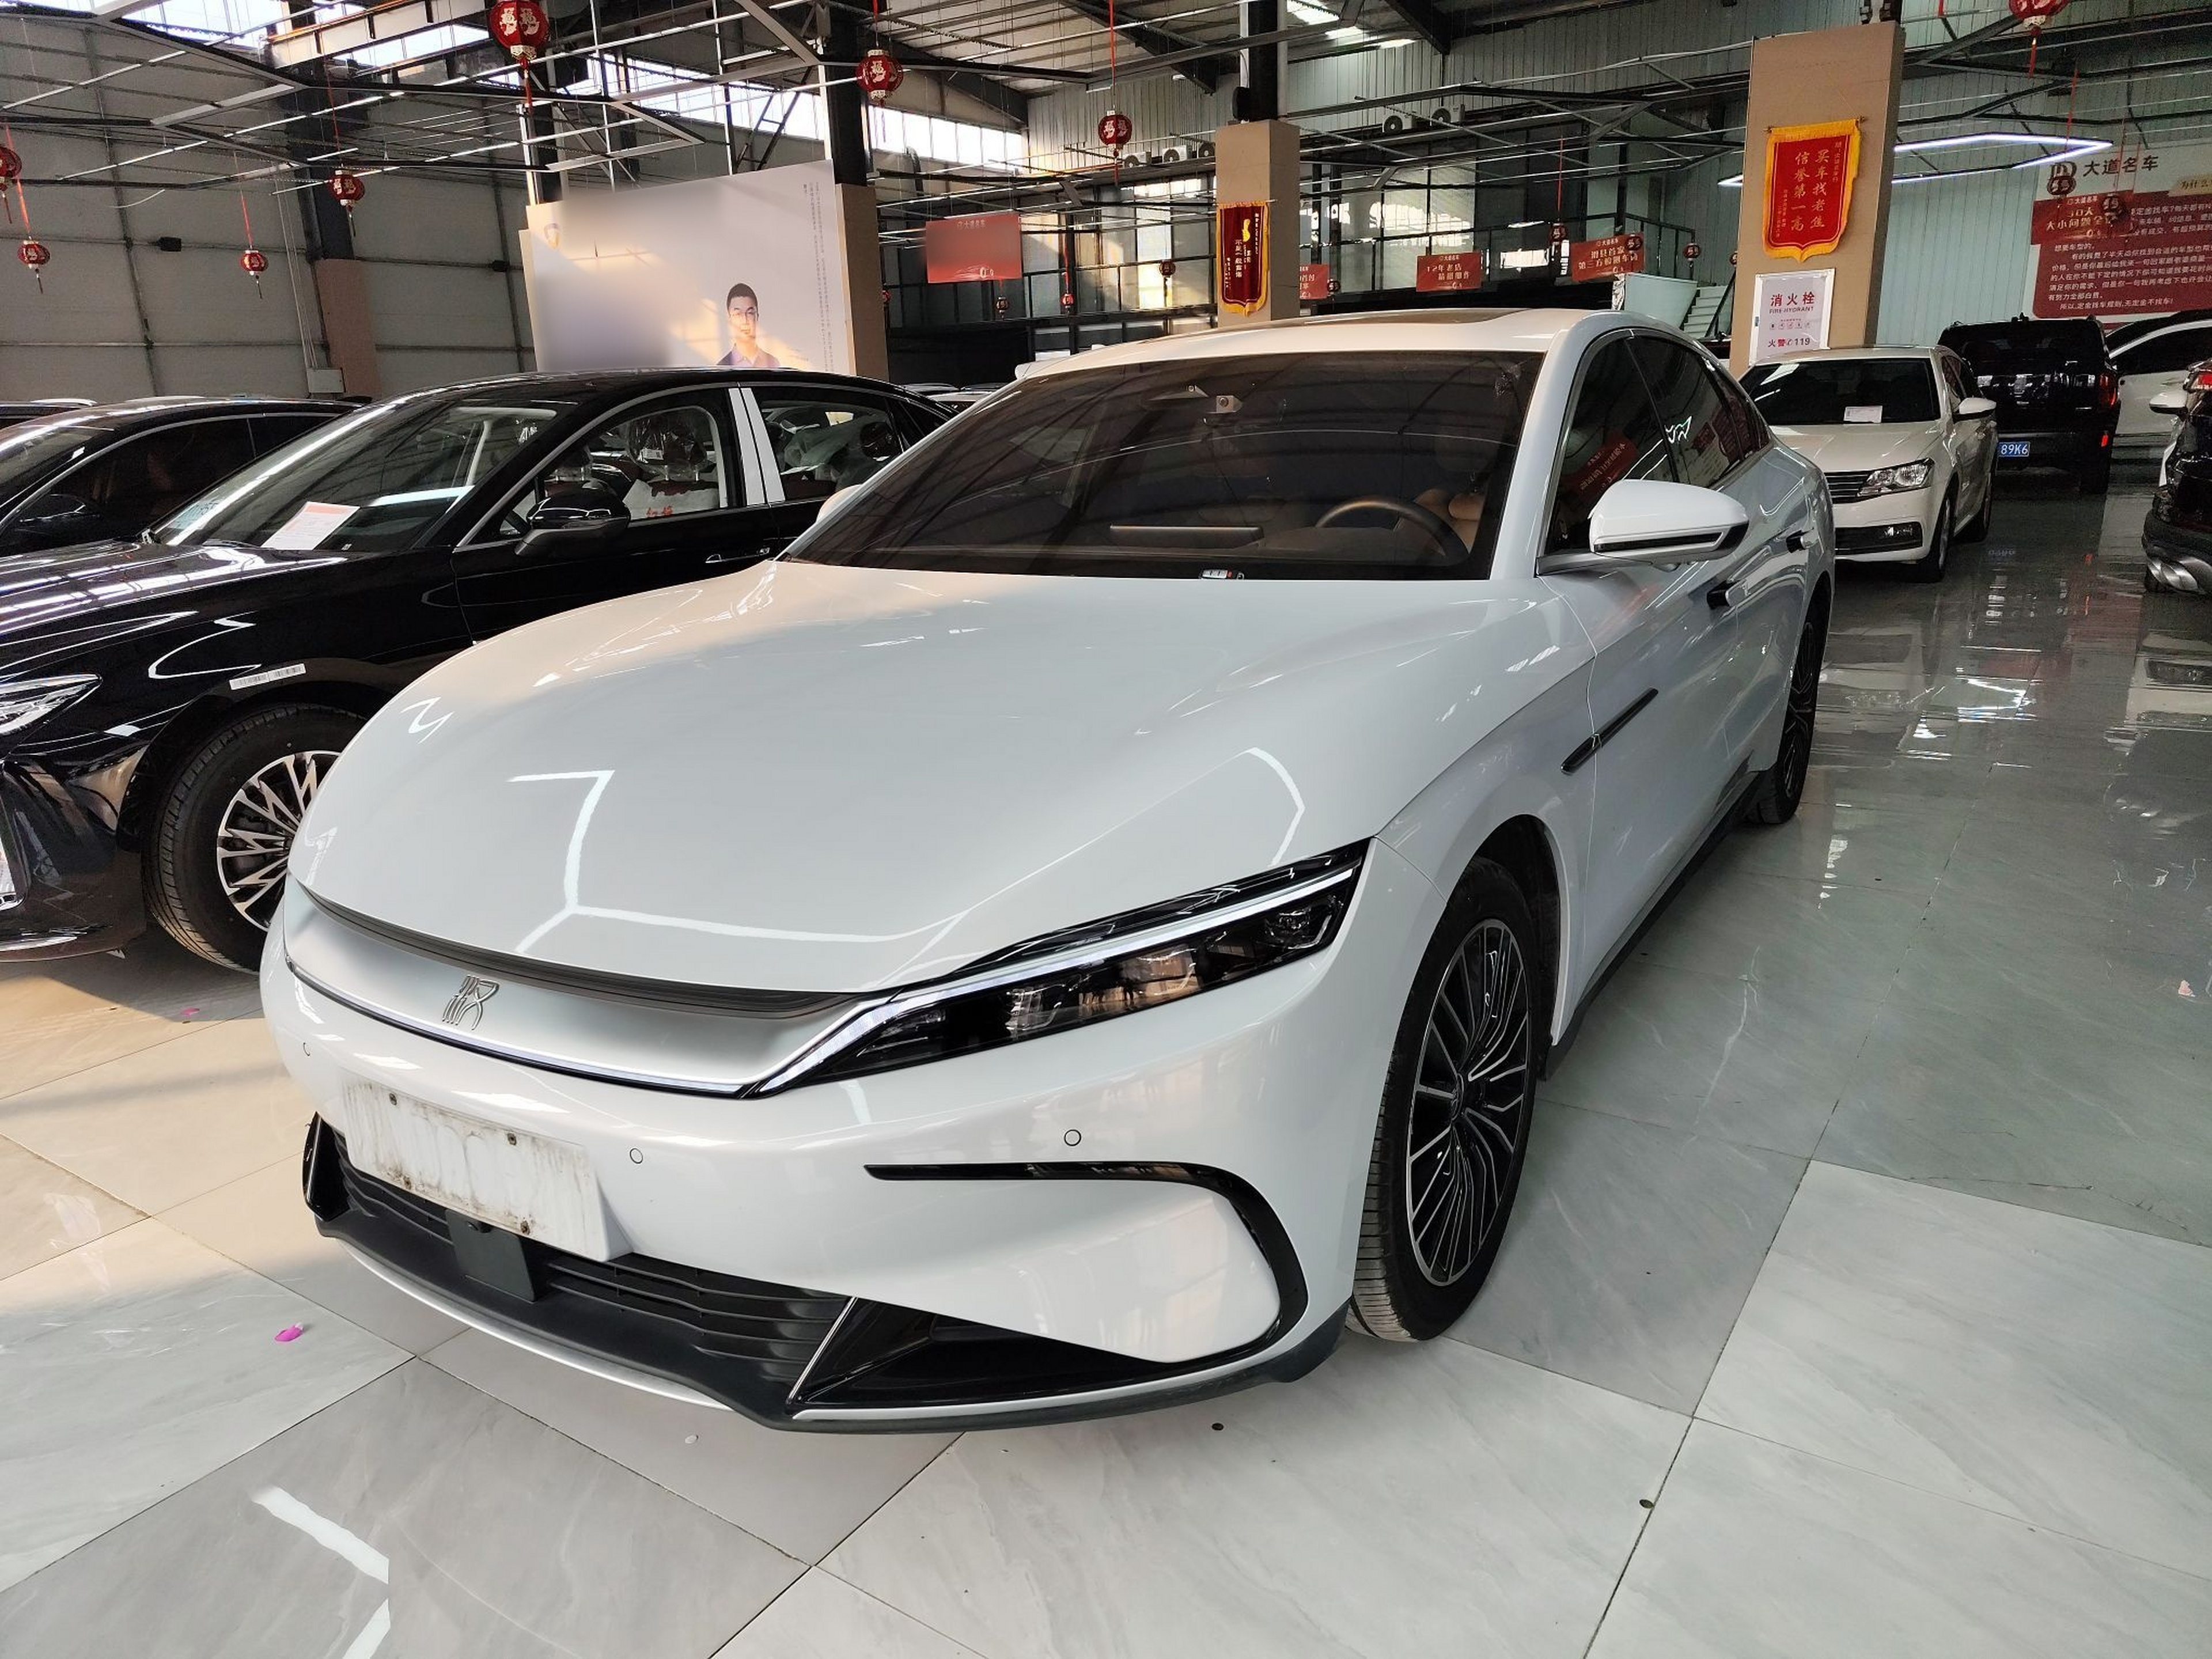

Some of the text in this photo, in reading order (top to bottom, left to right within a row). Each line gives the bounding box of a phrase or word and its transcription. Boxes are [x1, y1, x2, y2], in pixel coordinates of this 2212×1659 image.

[2082, 155, 2159, 177] 大道名车
[1791, 151, 1810, 231] 信誉第一高
[1770, 291, 1815, 307] 消火栓
[1768, 338, 1810, 348] 火警 119
[2001, 444, 2028, 454] 89K6
